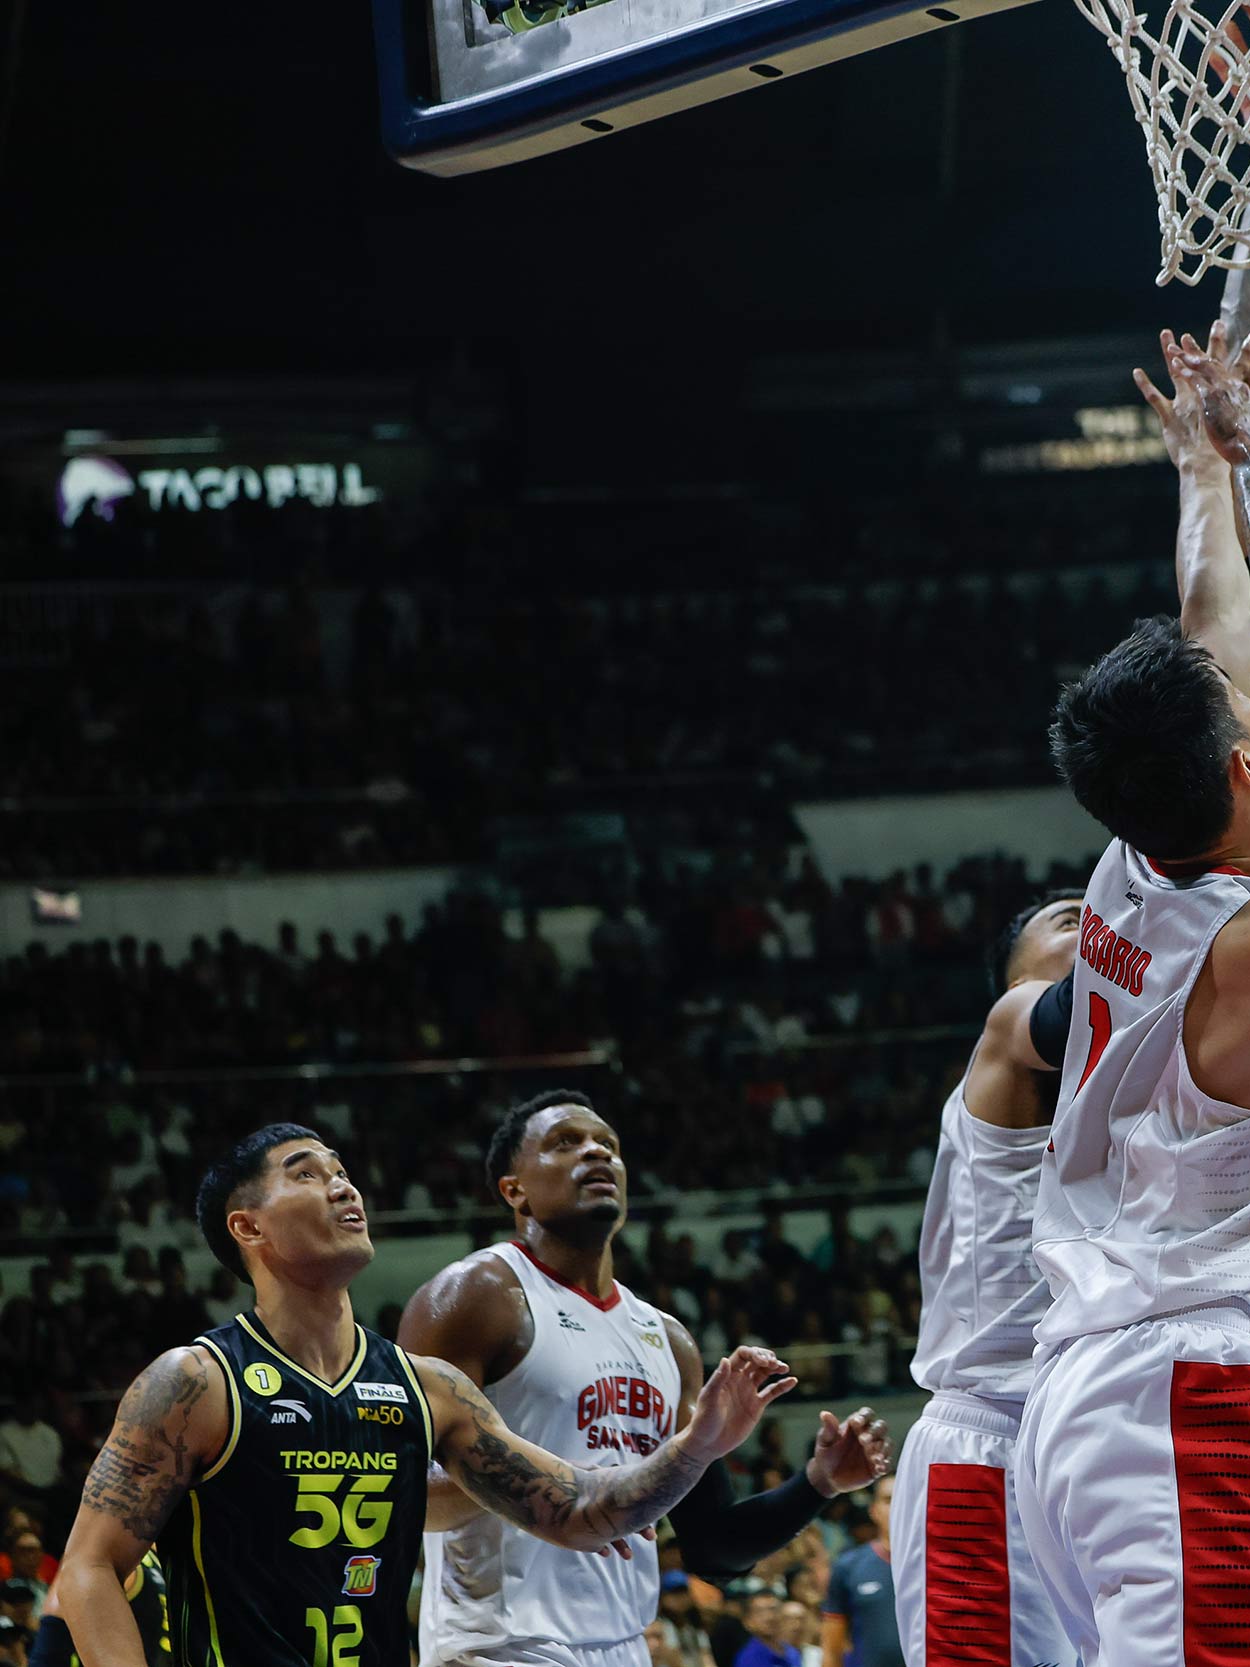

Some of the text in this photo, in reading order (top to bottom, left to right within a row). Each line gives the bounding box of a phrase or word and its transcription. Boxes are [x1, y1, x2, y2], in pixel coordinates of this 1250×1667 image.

[139, 465, 263, 512] TACO
[256, 1369, 269, 1390] 1
[358, 1387, 405, 1400] FINALS
[270, 1412, 297, 1424] ANTA
[280, 1450, 398, 1470] TROPANG
[283, 1474, 394, 1549] 5G
[343, 1560, 381, 1592] TNT
[305, 1604, 364, 1667] 12
